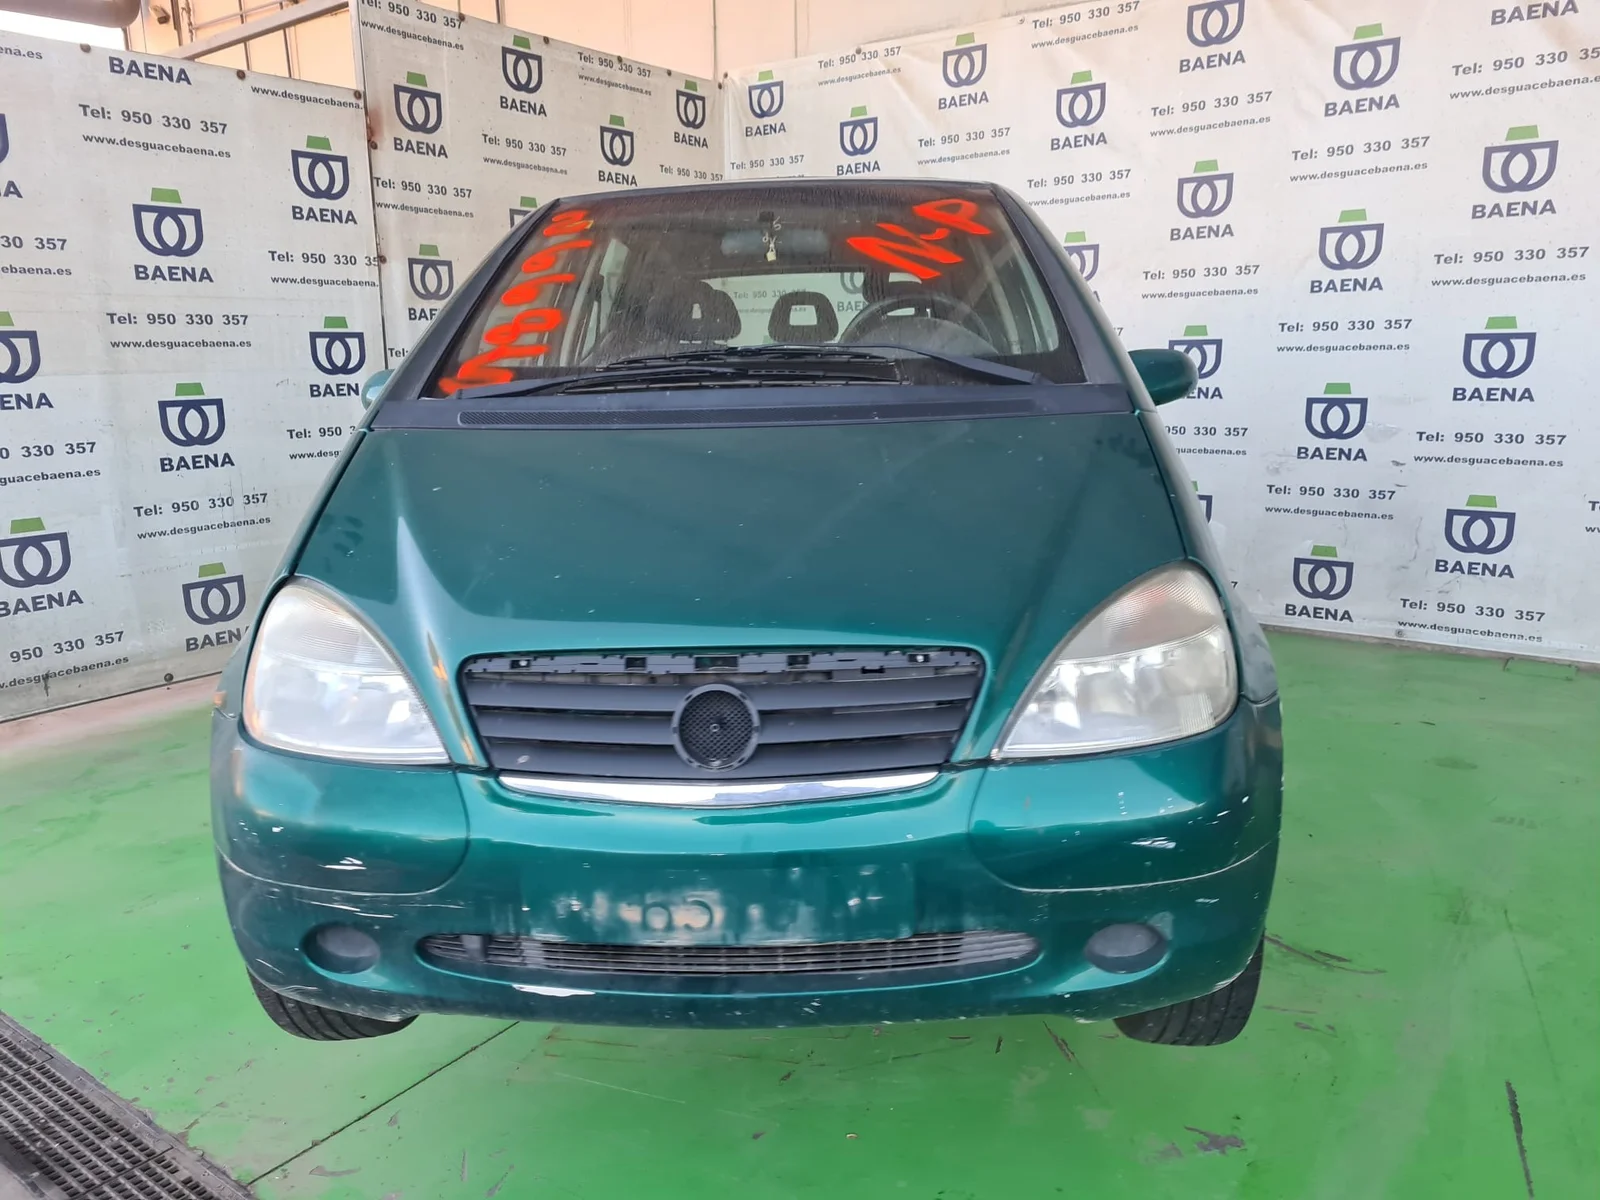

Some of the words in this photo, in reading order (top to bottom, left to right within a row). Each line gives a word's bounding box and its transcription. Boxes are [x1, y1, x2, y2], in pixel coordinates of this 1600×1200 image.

[388, 2, 410, 17] 950
[416, 9, 437, 24] 330
[443, 15, 463, 30] 357
[1032, 18, 1052, 29] Tel:
[1059, 12, 1081, 24] 950
[1088, 6, 1110, 19] 330
[1117, 0, 1140, 13] 357
[1490, 0, 1579, 25] BAENA
[361, 20, 464, 50] www.desguacebaena.es
[1031, 24, 1138, 49] www.desguacebaena.es
[578, 52, 594, 64] Tel:
[598, 57, 614, 69] 950
[618, 62, 633, 74] 330
[637, 68, 652, 78] 357
[818, 59, 834, 69] Tel:
[839, 54, 856, 65] 950
[861, 50, 879, 60] 330
[884, 46, 901, 57] 357
[1179, 50, 1246, 73] BAENA
[1452, 63, 1482, 76] Tel:
[1492, 57, 1524, 71] 950
[1535, 51, 1567, 66] 330
[109, 56, 192, 85] BAENA
[818, 67, 902, 87] www.desguacebaena.es
[578, 73, 652, 96] www.desguacebaena.es
[1450, 75, 1600, 99] www.desguacebaena.e
[251, 86, 364, 110] www.desguacebaena.
[500, 96, 547, 118] BAENA
[938, 91, 989, 110] BAENA
[1151, 105, 1174, 117] Tel:
[1181, 100, 1206, 113] 950
[1213, 95, 1239, 109] 330
[1246, 91, 1272, 105] 357
[1324, 94, 1400, 117] BAENA
[78, 104, 111, 120] Tel:
[121, 110, 152, 126] 950
[162, 116, 191, 131] 330
[200, 120, 228, 135] 357
[1150, 117, 1271, 137] www.desguacebaena.es
[745, 122, 787, 137] BAENA
[917, 139, 935, 148] Tel:
[940, 134, 960, 145] 950
[965, 132, 985, 142] 330
[991, 127, 1011, 138] 357
[82, 133, 231, 158] www.desguacebaena.es
[394, 137, 448, 159] BAENA
[482, 134, 500, 146] Tel:
[505, 137, 523, 150] 950
[528, 142, 545, 154] 330
[550, 147, 567, 157] 357
[674, 131, 709, 149] BAENA
[1050, 132, 1107, 151] BAENA
[1292, 149, 1318, 161] Tel:
[1327, 145, 1354, 158] 950
[1363, 141, 1391, 154] 330
[1401, 136, 1430, 149] 357
[483, 156, 568, 175] www.desguacebaena.es
[730, 161, 747, 170] Tel:
[749, 160, 765, 168] 950
[769, 157, 785, 167] 330
[789, 155, 804, 164] 357
[917, 149, 1010, 165] www.desguacebaena.es
[660, 165, 674, 175] Tel:
[677, 167, 690, 178] 950
[694, 171, 707, 180] 330
[711, 173, 723, 181] 357
[836, 161, 881, 176] BAENA
[1290, 162, 1428, 182] www.desguacebaena.es
[374, 177, 396, 190] Tel:
[401, 181, 421, 193] 950
[427, 184, 447, 197] 330
[453, 188, 472, 199] 357
[598, 170, 638, 187] BAENA
[1027, 178, 1047, 189] Tel:
[1053, 175, 1074, 186] 950
[1080, 172, 1102, 183] 330
[1109, 169, 1131, 180] 357
[291, 205, 357, 225] BAENA
[375, 201, 474, 218] www.desguacebaena.es
[1471, 199, 1557, 219] BAENA
[1170, 224, 1234, 240] BAENA
[34, 238, 67, 251] 357
[268, 250, 295, 262] Tel:
[301, 252, 326, 264] 950
[333, 253, 357, 266] 330
[1434, 253, 1463, 264] Tel:
[1473, 251, 1504, 263] 950
[1514, 249, 1545, 261] 330
[1556, 246, 1590, 258] 357
[134, 264, 214, 283] BAENA
[271, 275, 379, 287] www.desguacebaena.
[1143, 270, 1165, 280] Tel:
[1172, 268, 1196, 279] 950
[1203, 267, 1227, 277] 330
[1235, 265, 1260, 275] 357
[1432, 272, 1586, 287] www.desguacebaena.es
[1142, 287, 1259, 300] www.desguacebaena.es
[1310, 277, 1383, 293] BAENA
[106, 313, 138, 325] Tel:
[146, 313, 176, 325] 950
[185, 314, 213, 326] 330
[222, 314, 249, 326] 357
[1278, 322, 1304, 332] Tel:
[1312, 321, 1339, 332] 950
[1347, 320, 1375, 331] 330
[1384, 319, 1412, 330] 357
[110, 339, 251, 348] www.desguacebaena.es
[1277, 342, 1410, 353] www.desguacebaena.es
[309, 383, 359, 398] BAEN
[1452, 387, 1535, 402] BAENA
[0, 393, 54, 410] ENA
[287, 429, 312, 439] Tel:
[319, 427, 342, 437] 950
[1193, 426, 1216, 437] 330
[1224, 427, 1248, 437] 357
[1416, 431, 1445, 442] Tel:
[1454, 432, 1484, 443] 950
[1494, 433, 1525, 445] 330
[1535, 434, 1567, 445] 357
[20, 445, 54, 457] 330
[65, 442, 96, 454] 357
[1297, 446, 1367, 461] BAENA
[160, 453, 235, 472] BAENA
[1413, 455, 1563, 467] www.desguacebaena.es
[0, 469, 101, 486] guacebaena.es
[1266, 485, 1291, 495] Tel:
[1299, 486, 1325, 497] 950
[1333, 488, 1359, 499] 330
[1369, 489, 1396, 500] 357
[134, 506, 163, 518] Tel:
[172, 500, 199, 513] 950
[209, 497, 234, 509] 330
[244, 493, 268, 505] 357
[1265, 506, 1394, 520] www.desguacebaena.es
[137, 519, 271, 539] www.desguacebaena.es
[1434, 559, 1515, 578] BAENA
[1285, 604, 1353, 622] BAENA
[1400, 598, 1427, 610] Tel:
[1436, 602, 1466, 614] 950
[1475, 606, 1505, 618] 330
[1515, 610, 1546, 622] 357
[1398, 620, 1543, 643] www.desguacebaena.es
[10, 646, 43, 663] 950
[53, 638, 85, 654] 330
[94, 631, 125, 646] 357
